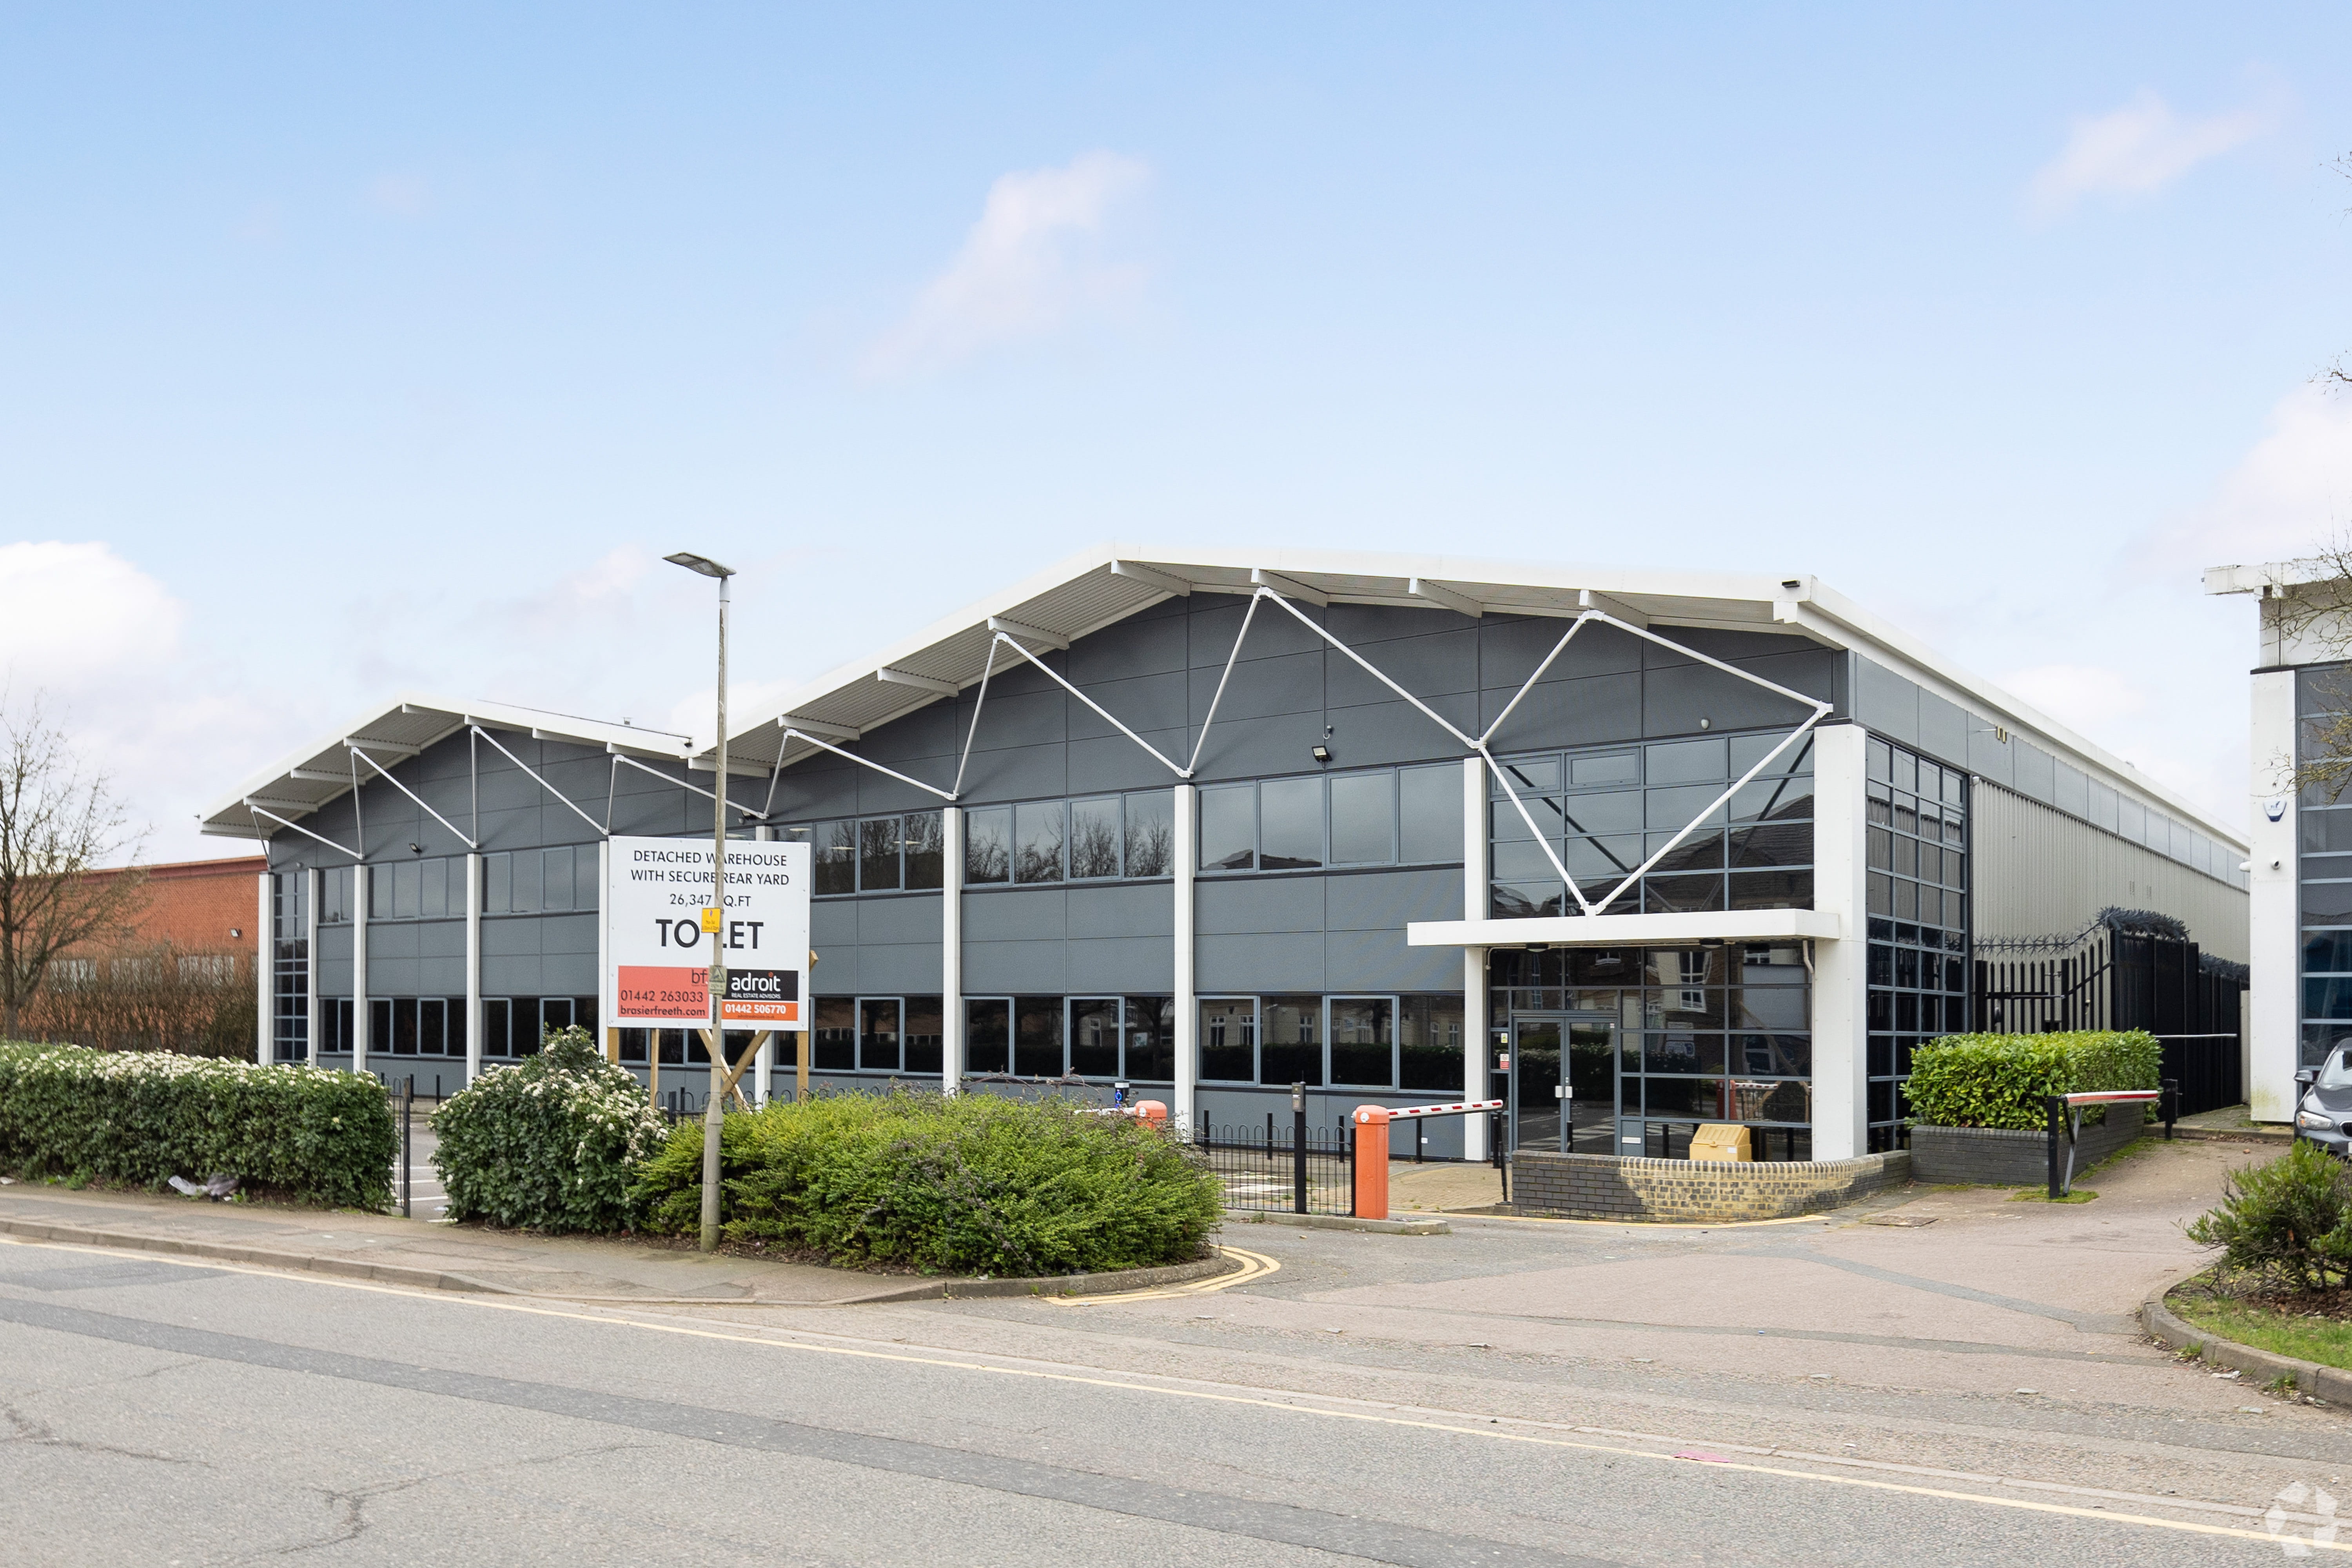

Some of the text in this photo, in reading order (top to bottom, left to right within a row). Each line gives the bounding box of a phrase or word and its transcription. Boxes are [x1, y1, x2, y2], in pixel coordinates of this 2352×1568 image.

[634, 850, 701, 863] DETACHED
[631, 869, 664, 881] WITH
[757, 873, 789, 885] YARD
[670, 893, 712, 907] 26,347
[655, 918, 764, 949] TO ET
[731, 971, 781, 992] adroit
[621, 989, 704, 1002] 01442 263033
[621, 1005, 706, 1016] brasierfreeth.com
[725, 1004, 786, 1014] 01442 506770
